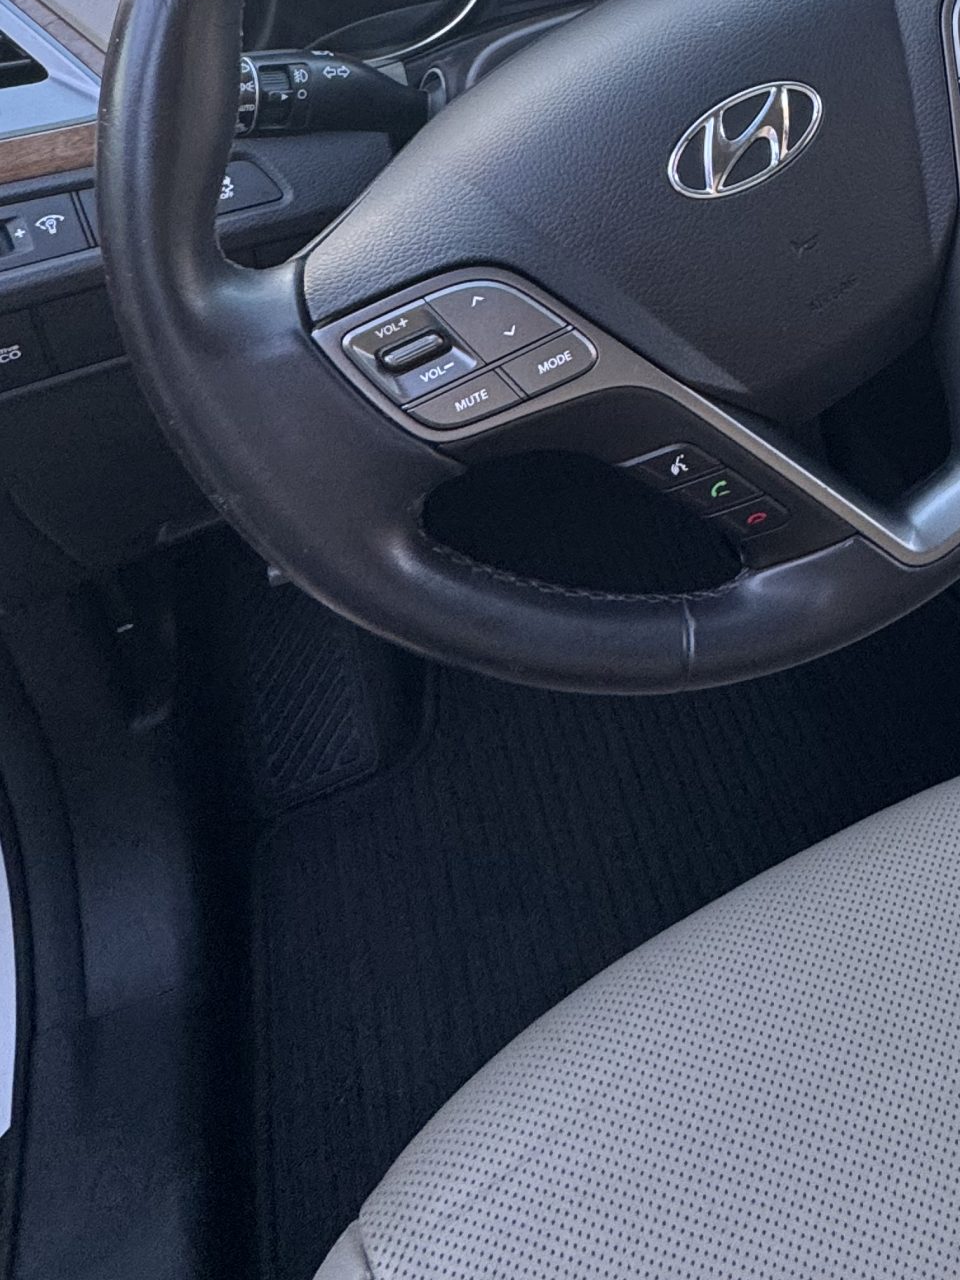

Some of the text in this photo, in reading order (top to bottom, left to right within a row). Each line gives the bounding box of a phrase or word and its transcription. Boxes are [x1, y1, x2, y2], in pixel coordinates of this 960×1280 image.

[374, 317, 409, 339] VOL+
[418, 361, 455, 382] VOL-
[536, 349, 573, 375] MODE
[454, 387, 490, 412] MUTE
